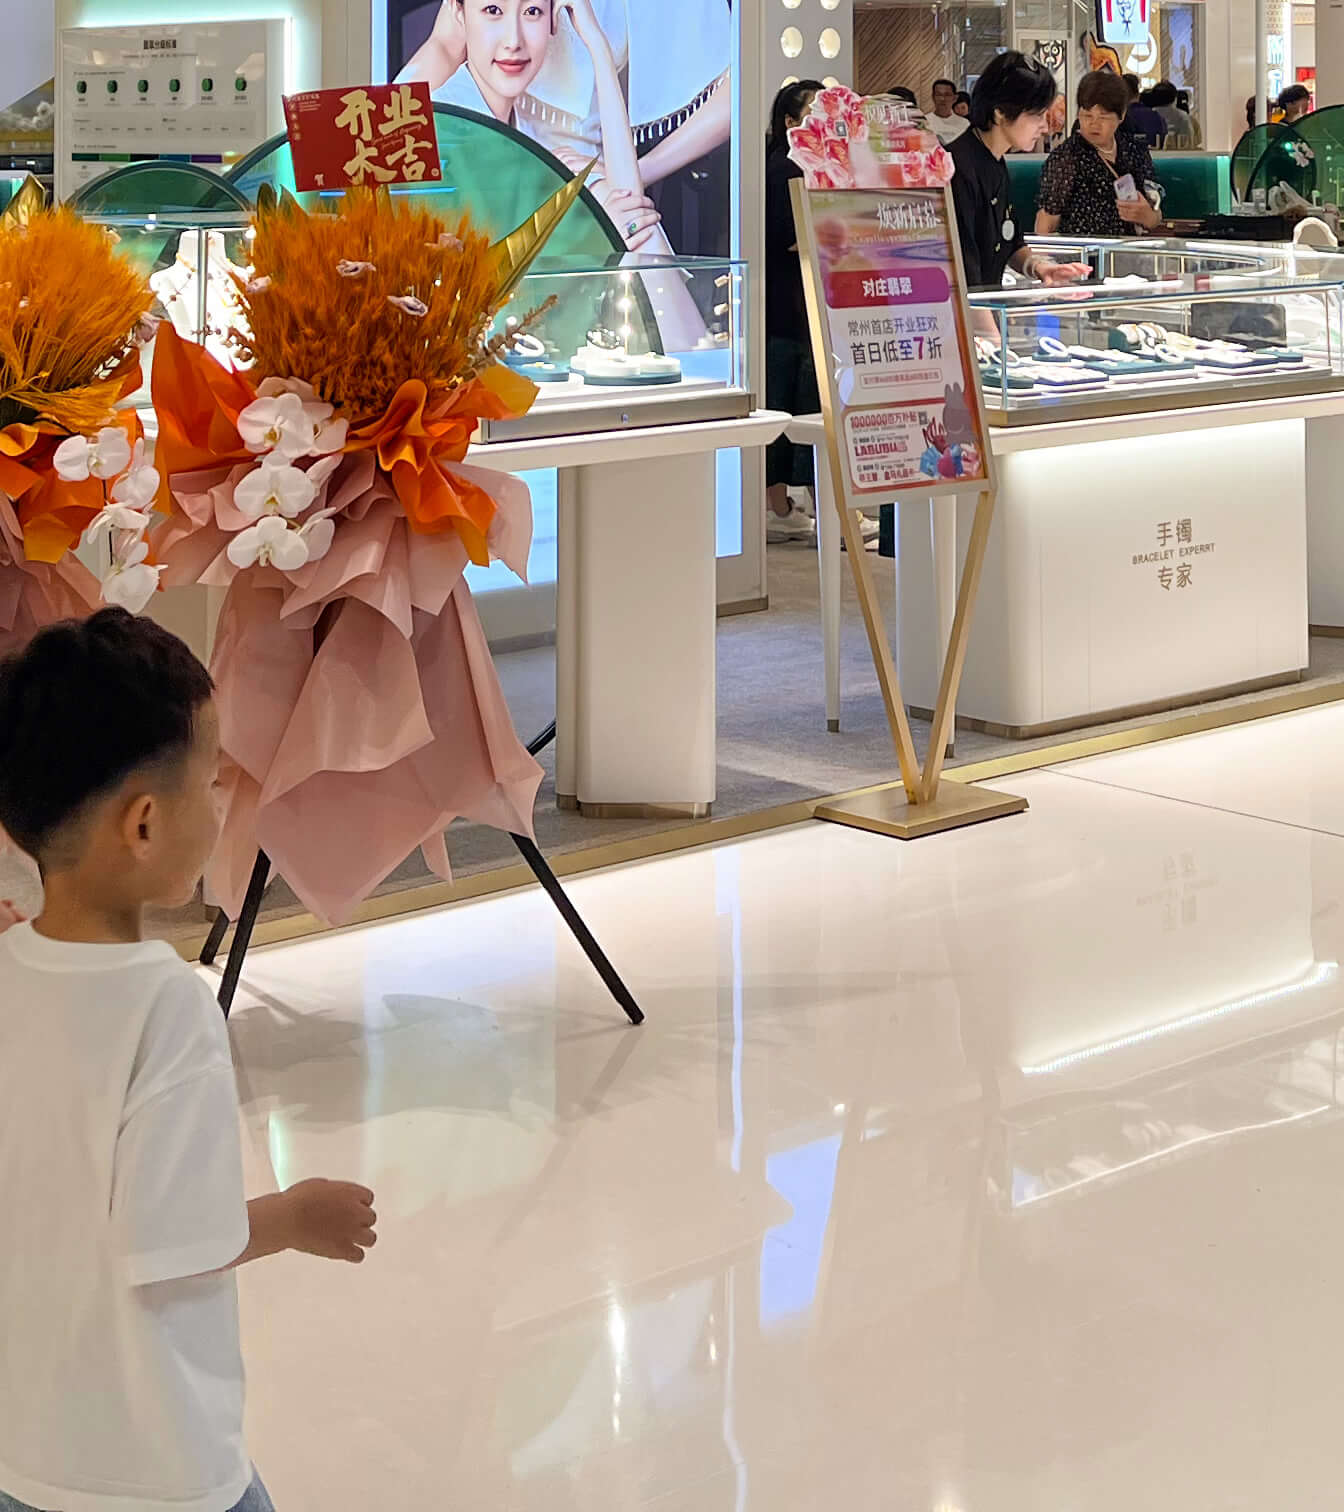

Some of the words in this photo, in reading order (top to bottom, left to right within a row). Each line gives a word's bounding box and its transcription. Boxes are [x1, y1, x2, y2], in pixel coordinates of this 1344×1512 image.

[334, 85, 429, 142] 开业
[343, 134, 433, 187] 大吉
[861, 276, 913, 297] 对庄翡翠
[847, 316, 939, 337] 常州首店开业狂欢
[850, 336, 943, 366] 首日低至7折
[1156, 518, 1192, 547] 手镯
[1132, 548, 1175, 565] BRACELET
[1156, 562, 1192, 591] 专家
